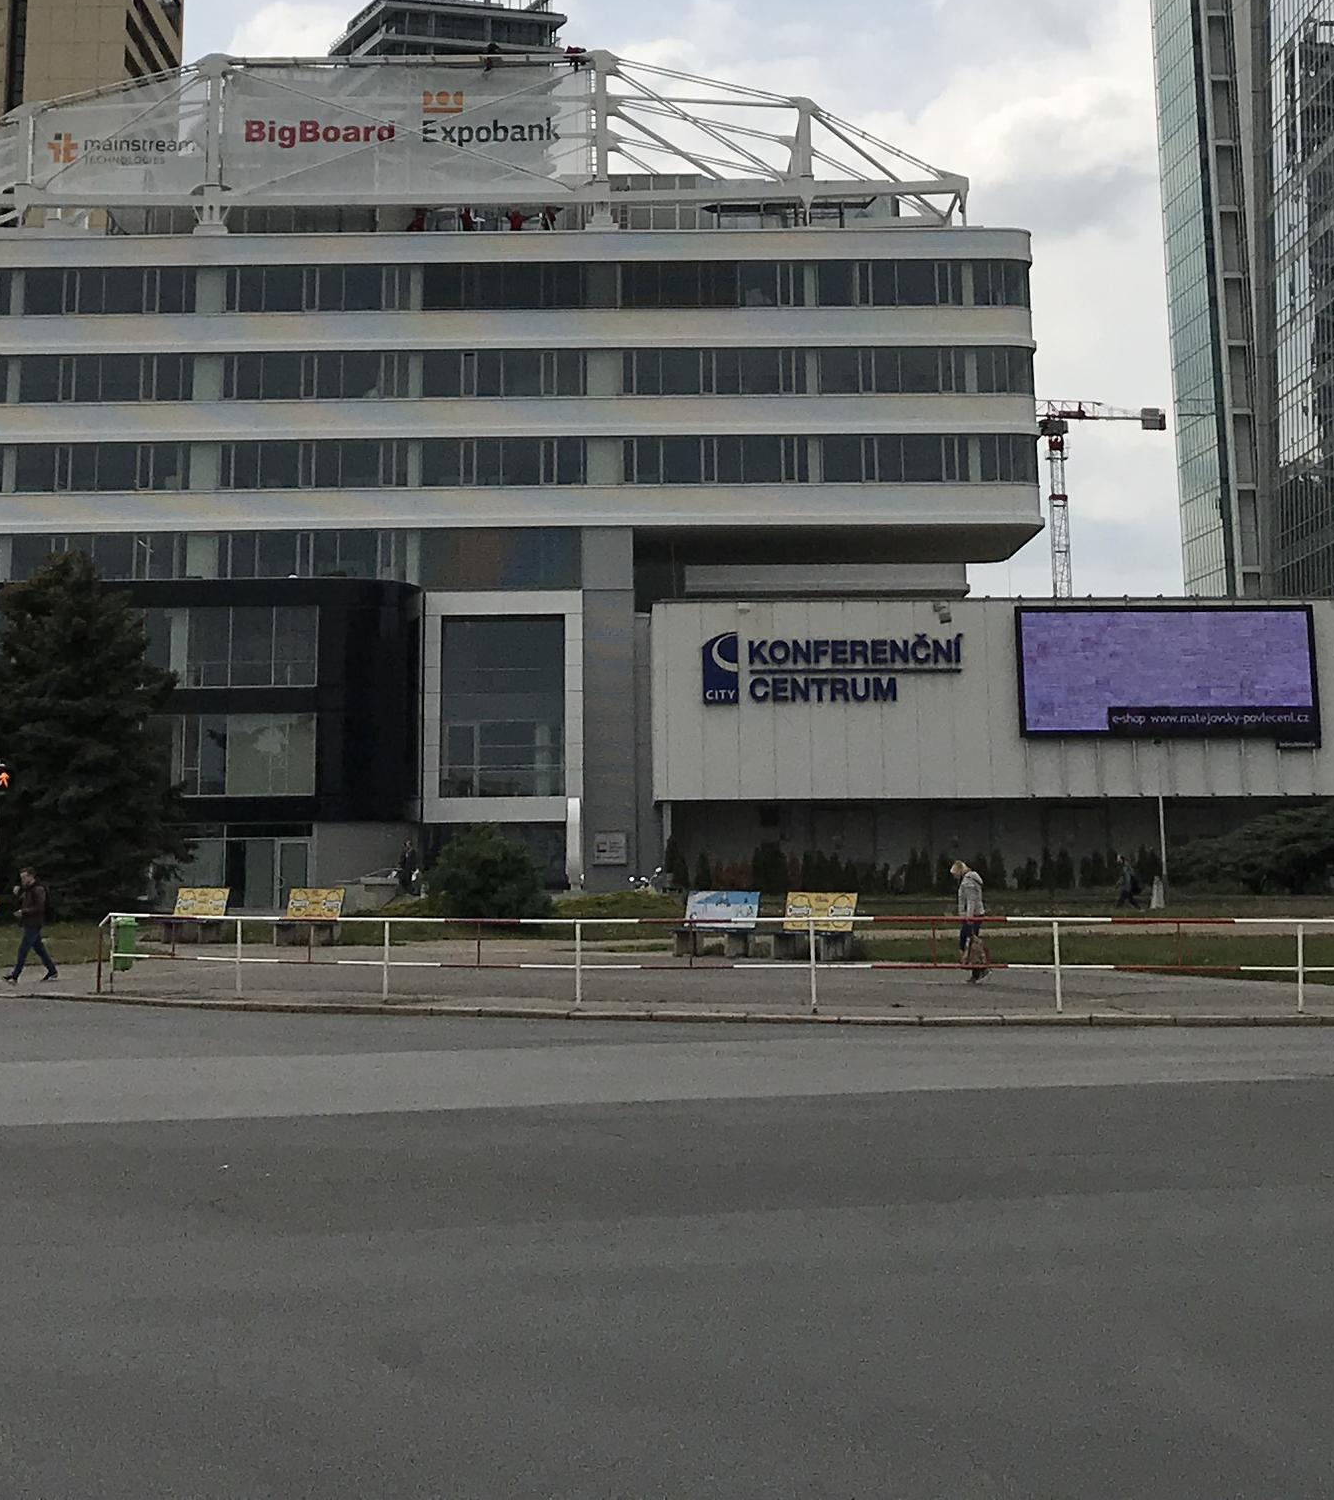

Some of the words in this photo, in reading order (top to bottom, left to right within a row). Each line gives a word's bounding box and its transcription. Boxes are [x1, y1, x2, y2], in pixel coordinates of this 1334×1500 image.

[244, 120, 396, 148] BigBoard
[422, 117, 561, 147] Expobank
[84, 138, 196, 153] mainstream
[747, 633, 964, 665] KONFERENČNÍ
[705, 688, 736, 700] CITY
[748, 677, 898, 703] CENTRUM
[1112, 713, 1146, 725] e-shop
